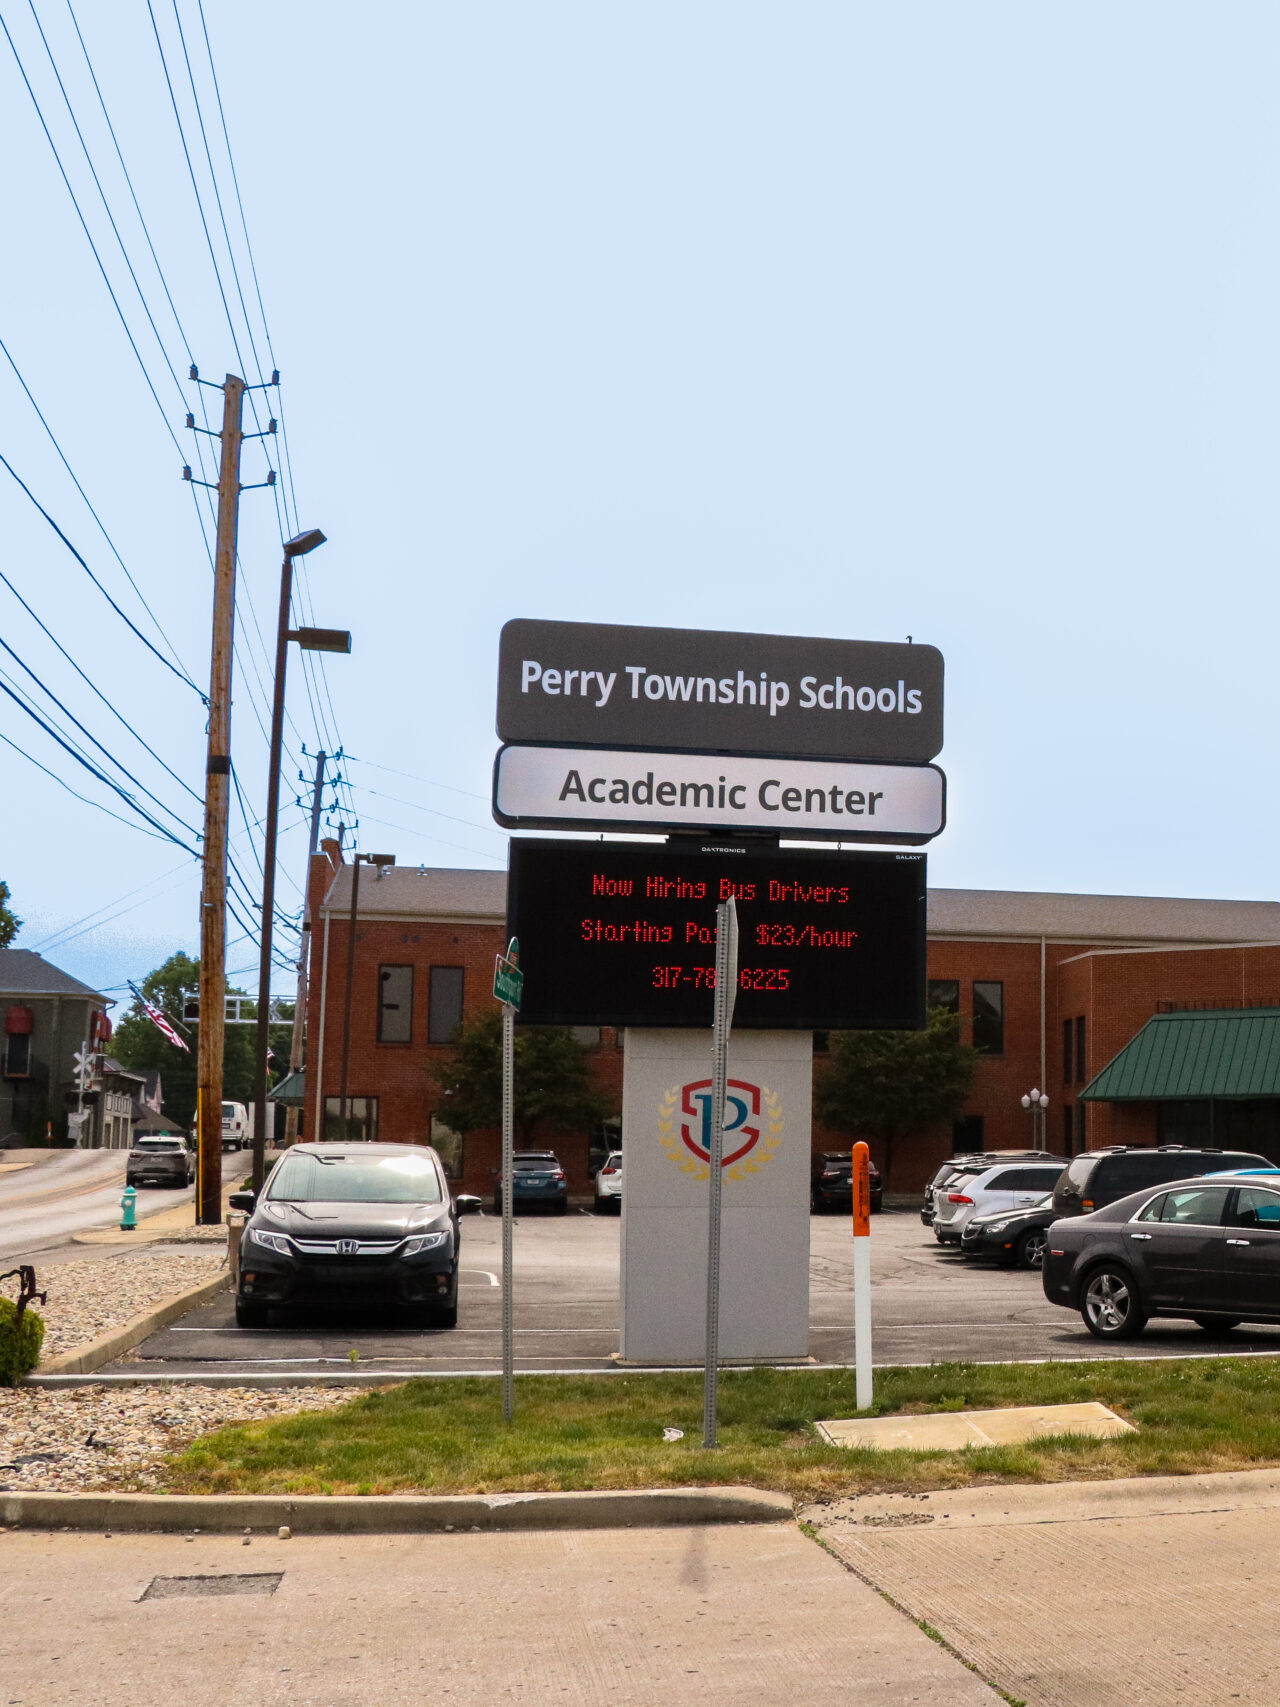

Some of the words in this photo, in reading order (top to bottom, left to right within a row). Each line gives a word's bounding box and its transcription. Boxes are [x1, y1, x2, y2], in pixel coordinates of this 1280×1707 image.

[521, 660, 617, 707] Perry
[625, 666, 790, 716] Township
[799, 676, 922, 714] Schools
[558, 769, 747, 810] Academic
[758, 779, 884, 815] Center
[592, 874, 633, 897] Now
[646, 876, 707, 899] Hiring
[719, 878, 756, 901] Bus
[769, 880, 850, 903] Drivers
[581, 919, 673, 943] Starting
[686, 922, 718, 944] Pa
[756, 924, 859, 948] $23/hour
[652, 966, 790, 990] 317-786225
